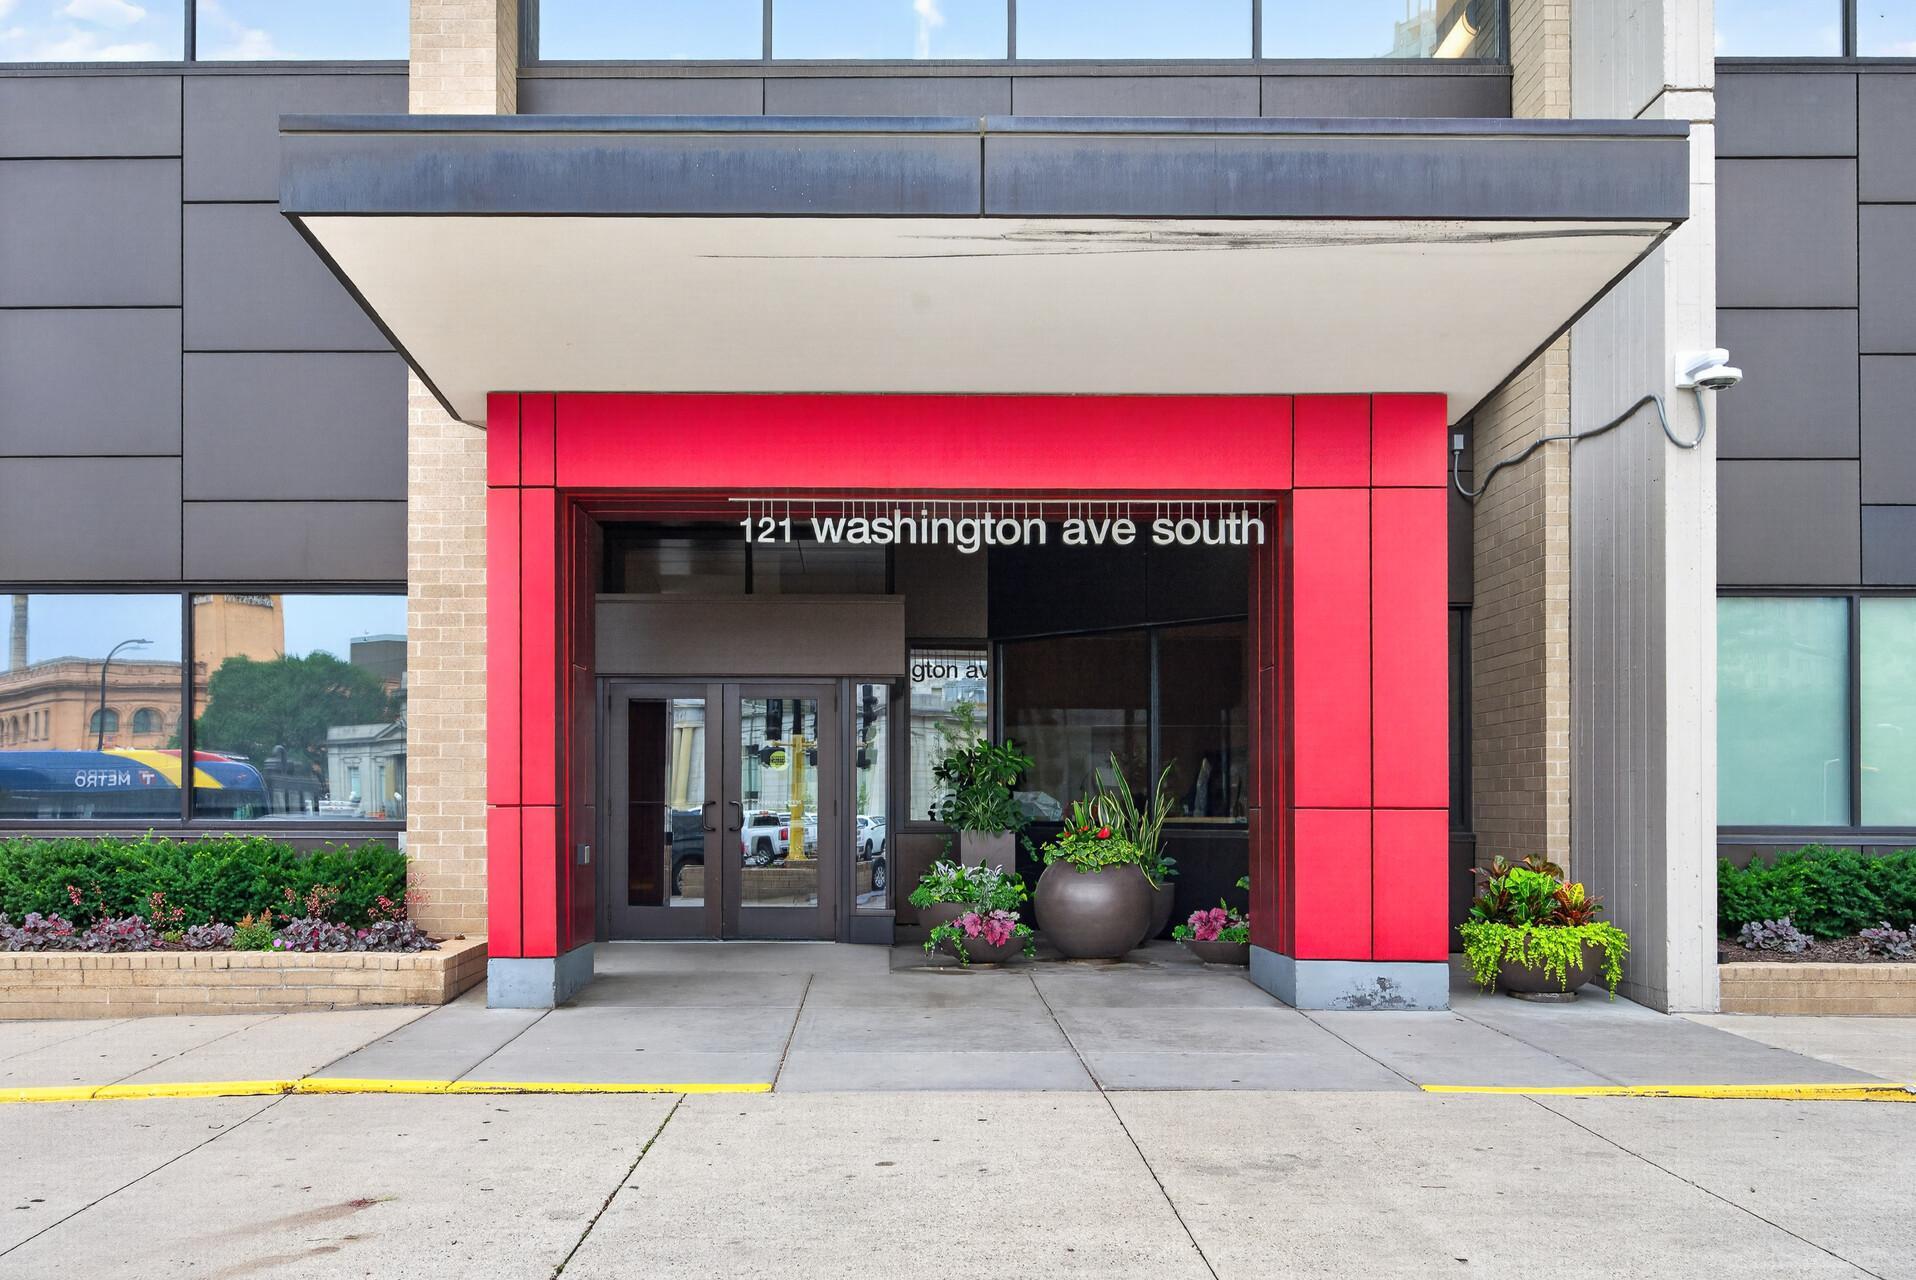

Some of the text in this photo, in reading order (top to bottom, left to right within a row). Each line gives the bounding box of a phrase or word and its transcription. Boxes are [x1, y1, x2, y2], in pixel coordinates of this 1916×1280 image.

[740, 509, 1264, 553] 121 washington ave south
[912, 660, 958, 682] gton
